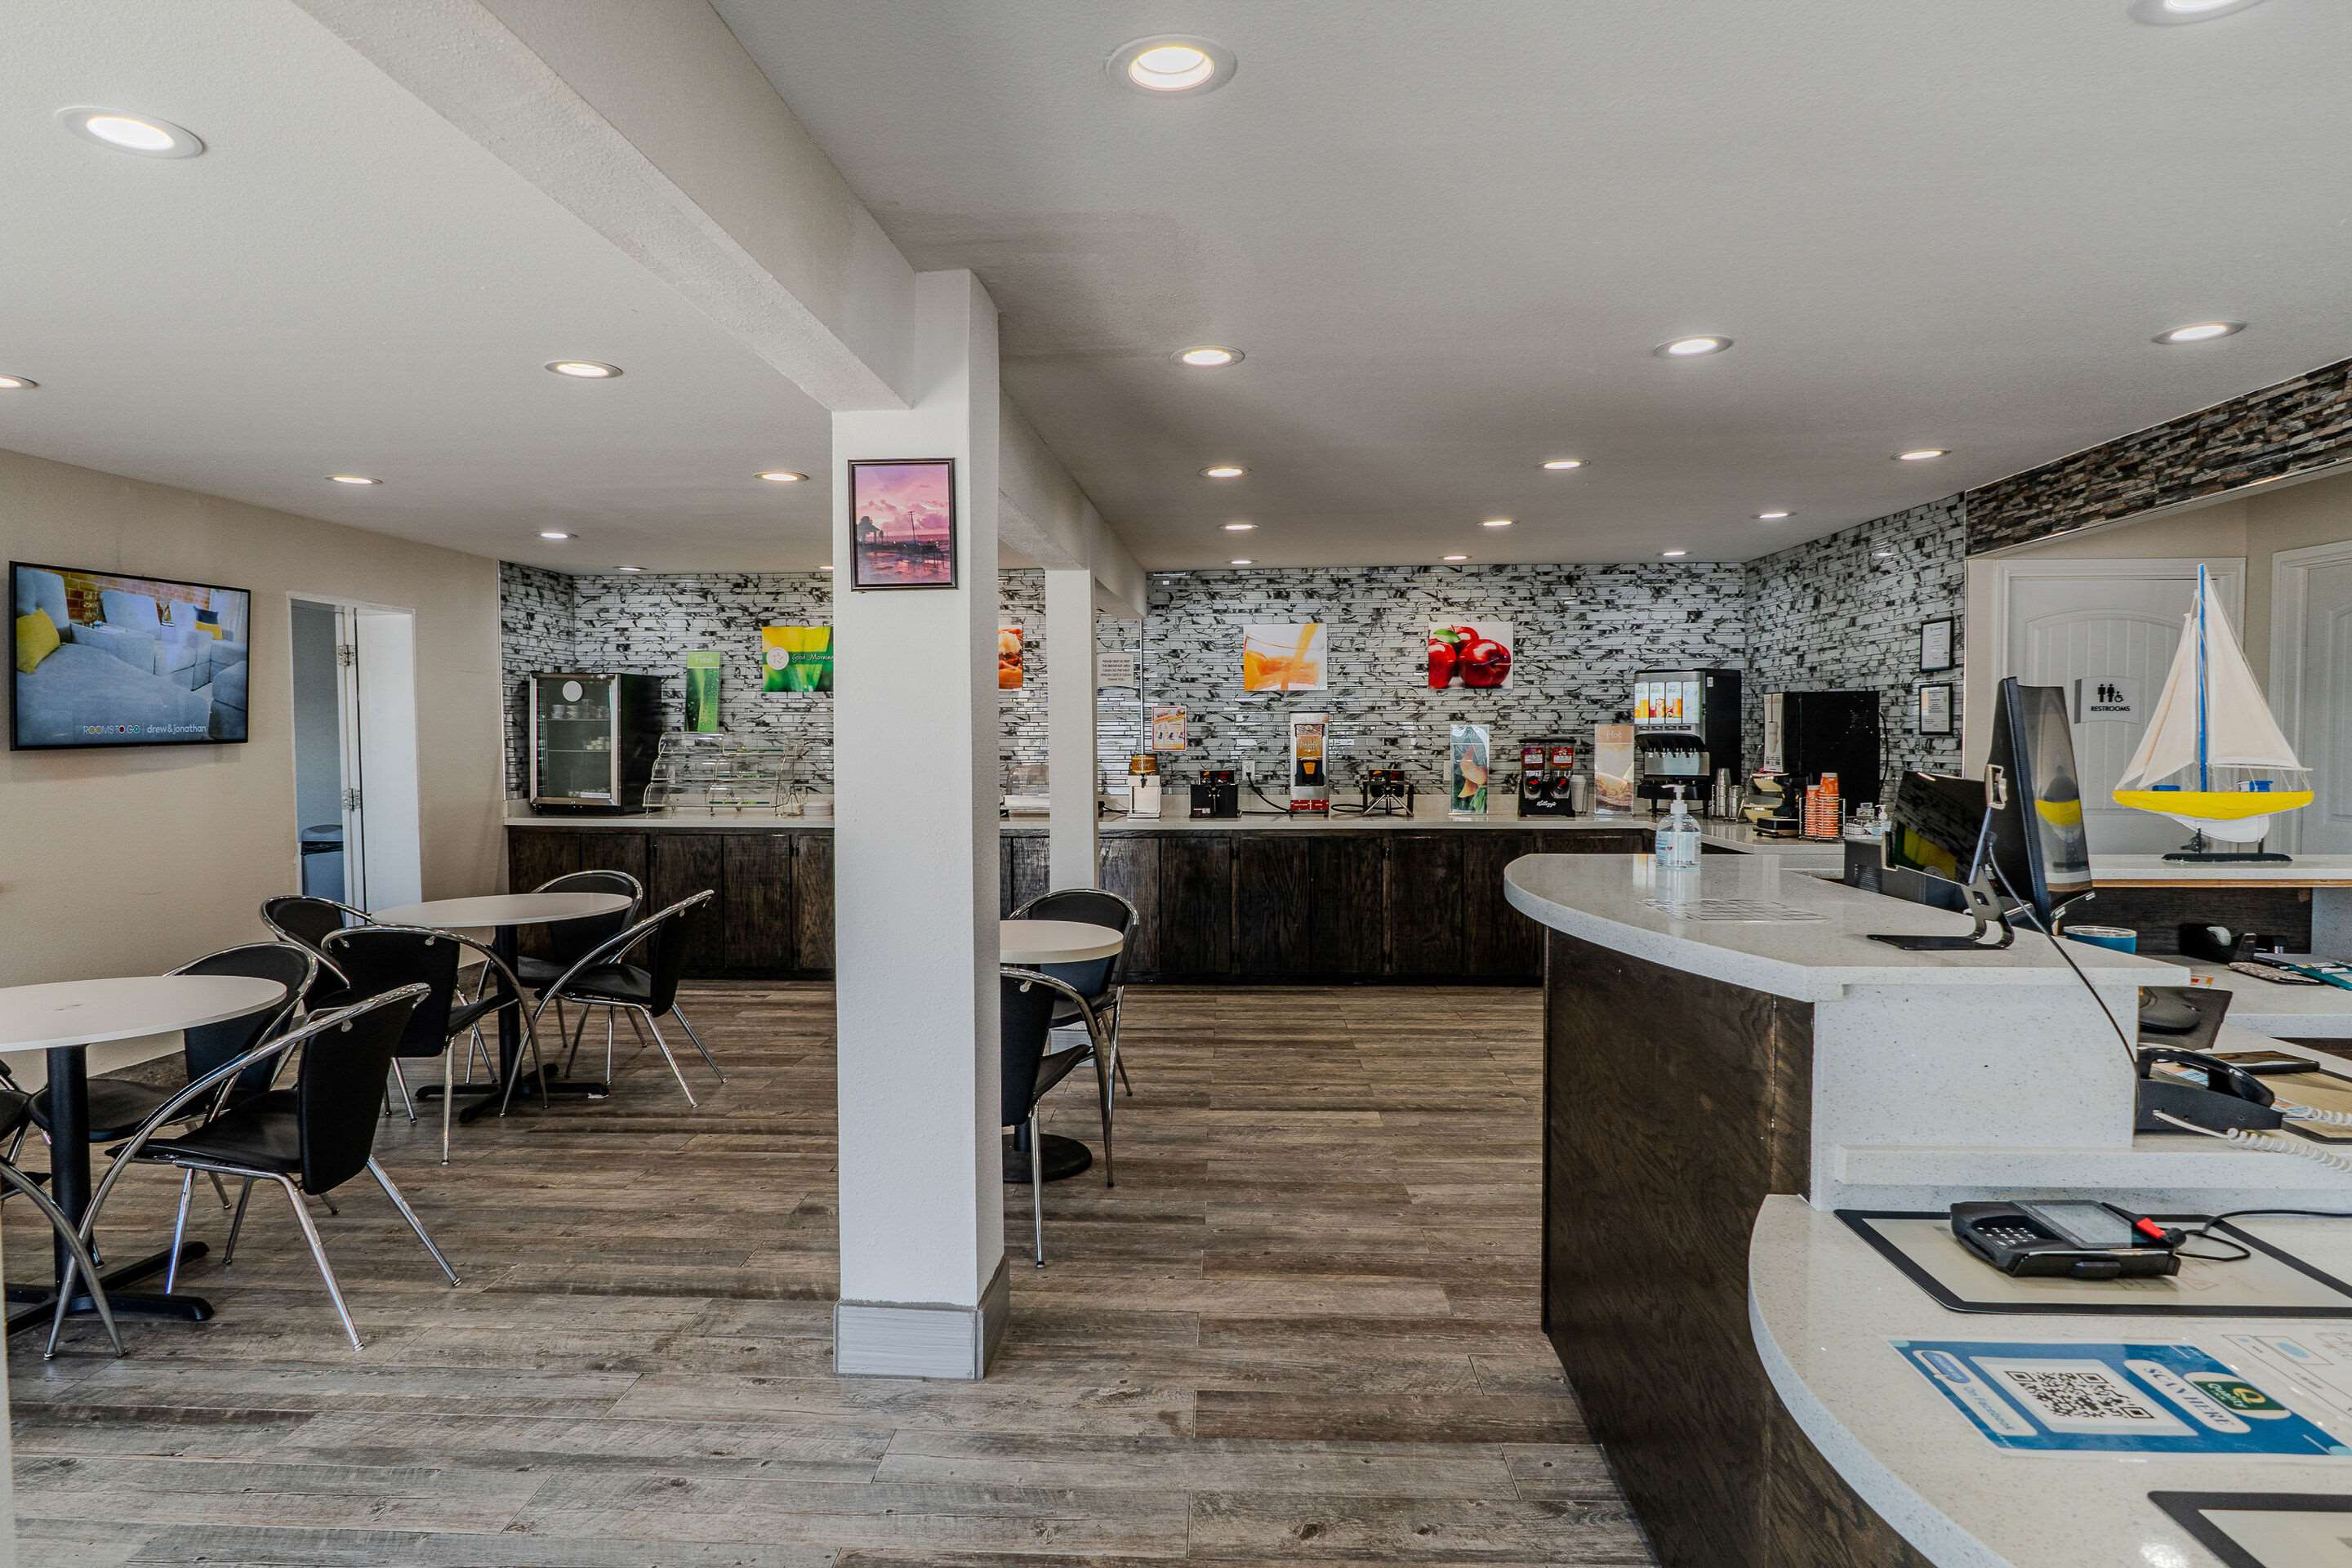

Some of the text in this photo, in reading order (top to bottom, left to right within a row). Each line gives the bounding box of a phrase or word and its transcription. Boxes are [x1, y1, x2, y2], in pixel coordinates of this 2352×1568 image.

[83, 725, 114, 734] ROOMS
[127, 725, 140, 733] GO
[2143, 1369, 2236, 1425] SCAN HERE
[2207, 1383, 2249, 1408] Quality
[1973, 1397, 2016, 1430] Facebook
